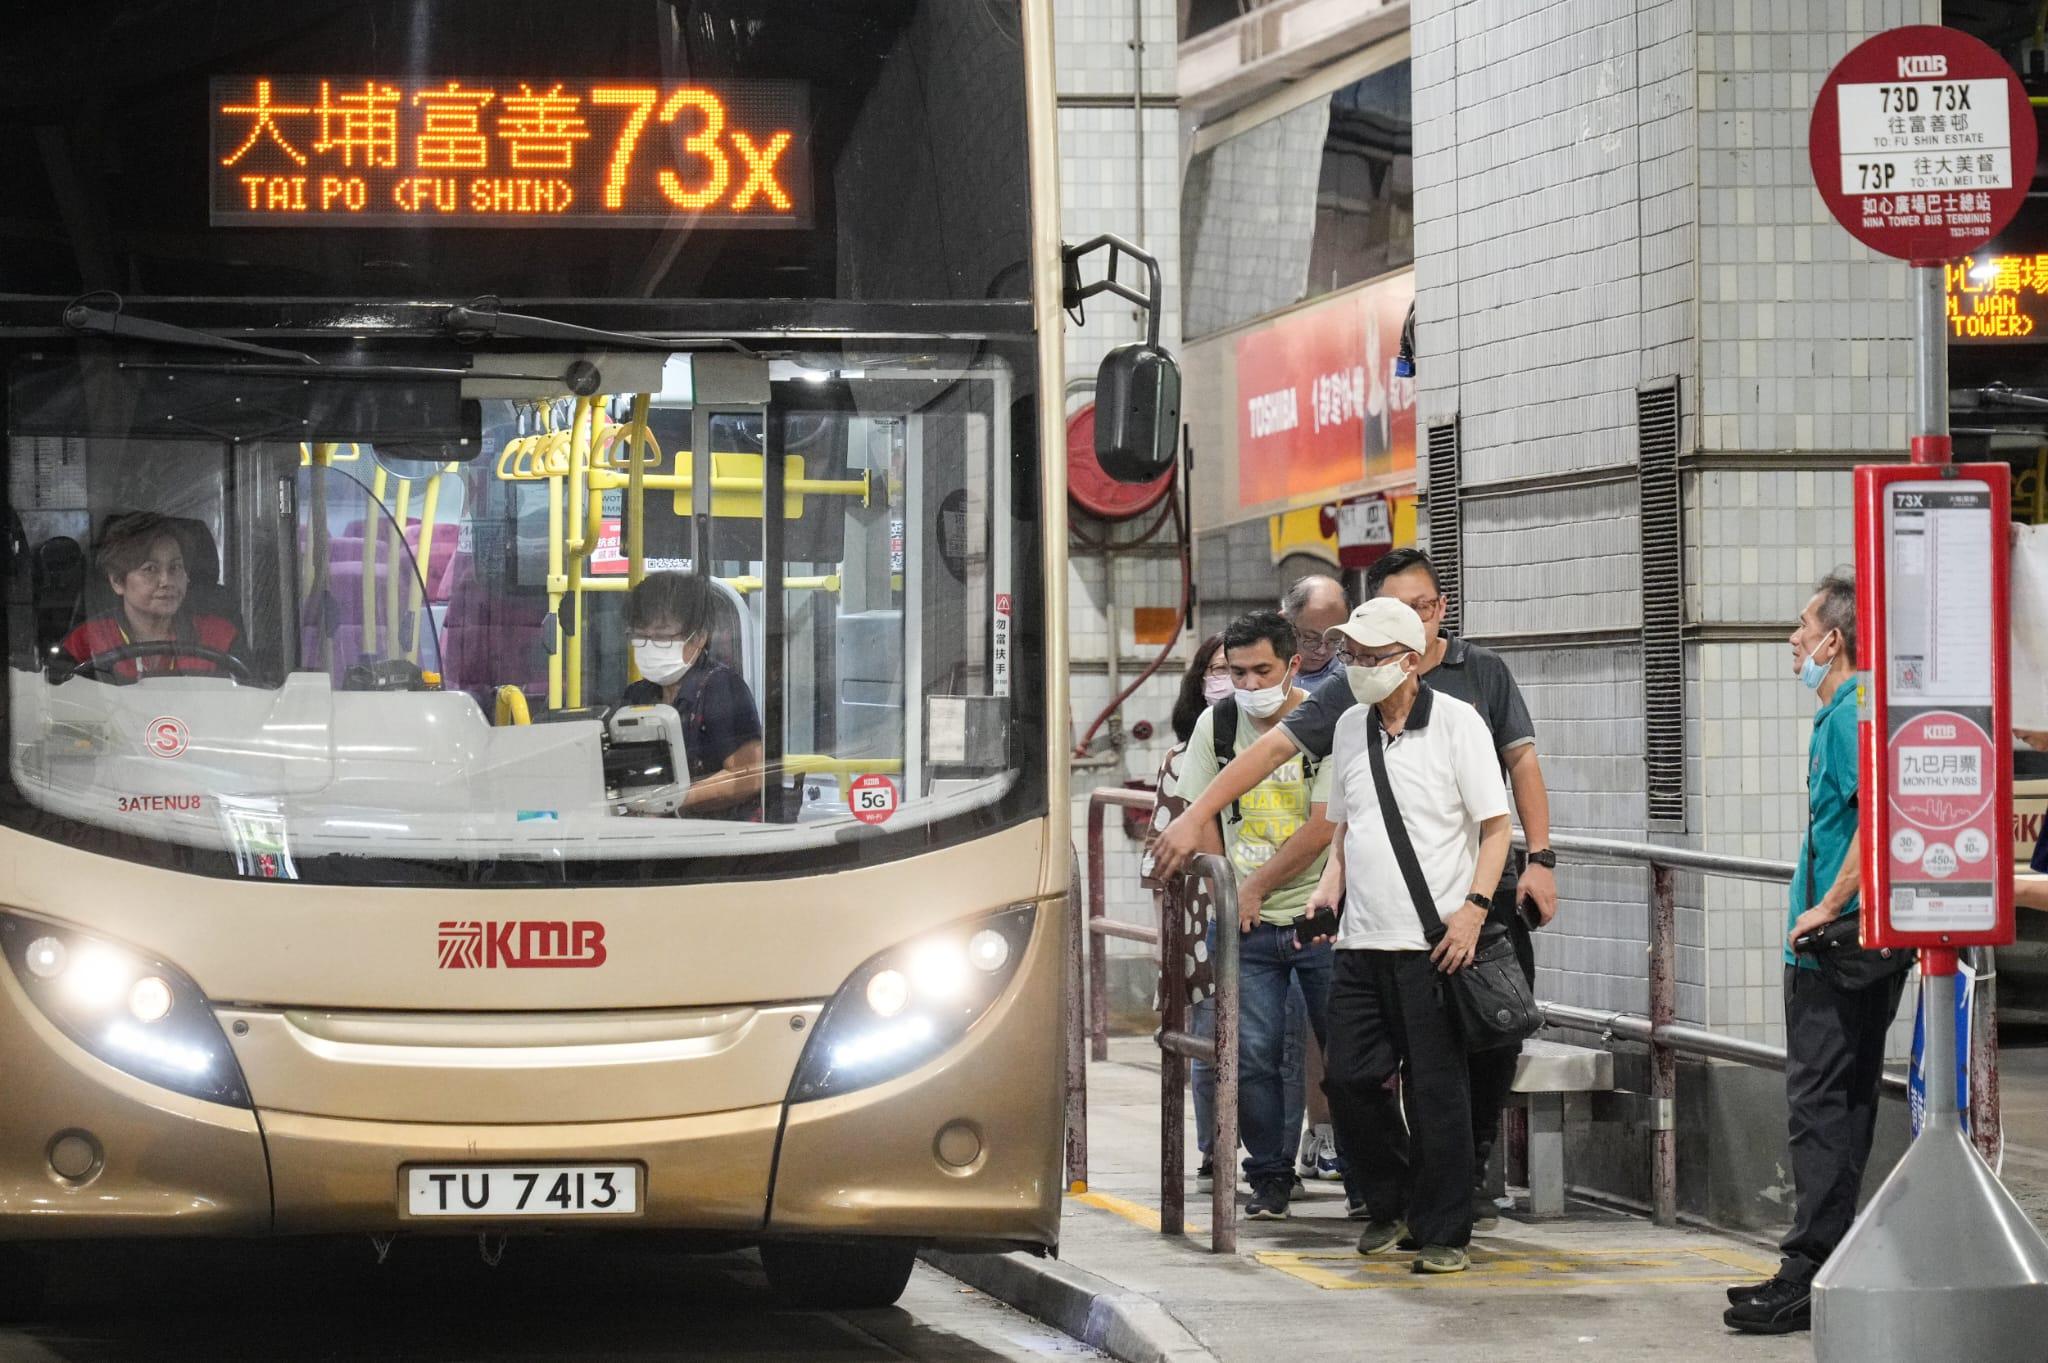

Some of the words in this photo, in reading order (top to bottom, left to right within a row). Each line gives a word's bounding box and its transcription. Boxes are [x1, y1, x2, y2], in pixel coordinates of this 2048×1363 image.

[1897, 55, 1948, 78] KMB
[1880, 87, 1918, 112] 73D
[1932, 84, 1971, 111] 73X
[222, 81, 589, 168] 大埔富善
[1888, 114, 1968, 134] 往富善邨
[1895, 136, 1908, 146] FU
[1914, 135, 1939, 145] SHIN
[1945, 133, 1984, 144] ESTATE
[1914, 154, 1995, 175] 往大美督
[1858, 163, 1895, 190] 73P
[1932, 177, 1948, 187] TAI
[1954, 176, 1973, 186] MEI
[1979, 174, 2000, 185] TUK
[241, 177, 306, 210] TAI
[322, 177, 366, 210] PO
[1862, 192, 1991, 215] 如心廣場巴士總站
[1862, 217, 1885, 228] NINA
[1888, 215, 1920, 227] TOWER
[1924, 214, 1943, 225] BUS
[1946, 213, 1992, 224] TERMINUS
[1974, 295, 2016, 316] WAN
[1248, 387, 1299, 439] TOSHIBA
[1897, 494, 1923, 508] 73X
[156, 724, 178, 751] S
[1904, 755, 1977, 773] 九巴月票
[1903, 776, 1949, 786] MONTHLY
[1952, 775, 1977, 786] PASS
[118, 796, 200, 812] 3ATENU8
[861, 791, 885, 809] 5G
[487, 920, 607, 968] KMB
[428, 1173, 490, 1210] TU
[512, 1172, 617, 1210] 7413
